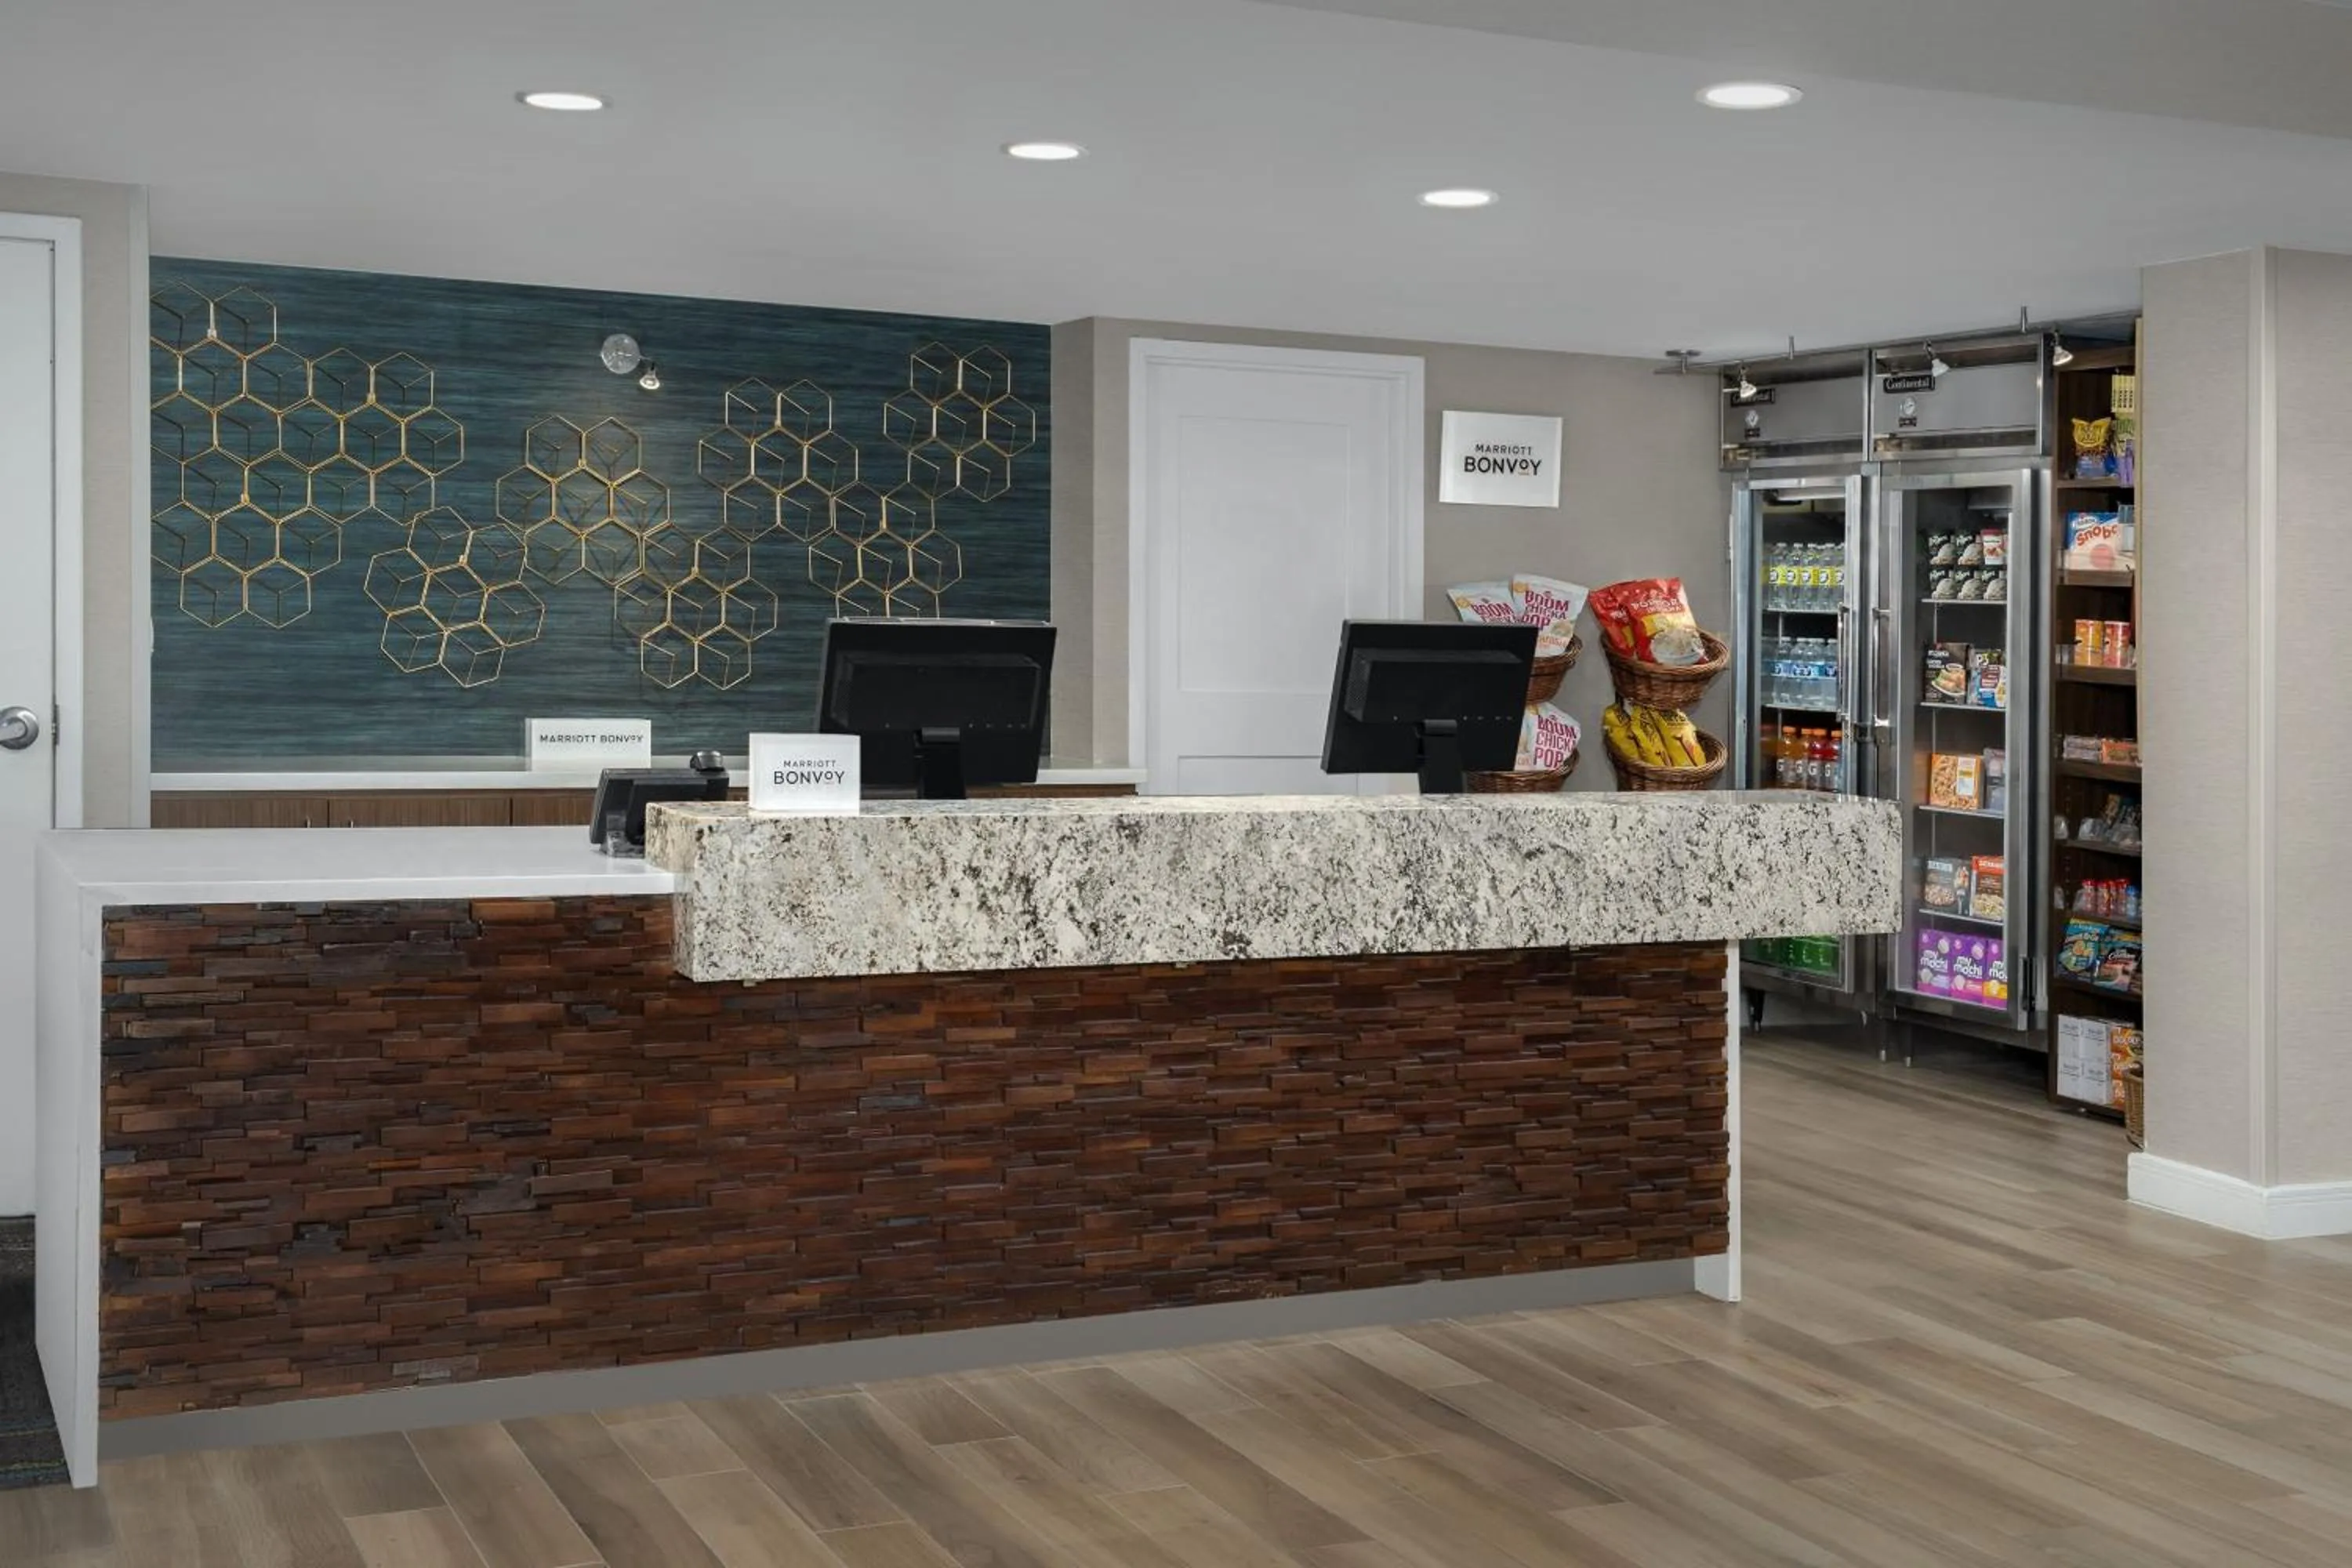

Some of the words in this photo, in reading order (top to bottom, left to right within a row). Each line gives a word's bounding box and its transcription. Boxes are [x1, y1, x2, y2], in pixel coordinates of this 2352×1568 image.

[1475, 444, 1534, 456] MARRIOTT
[1464, 456, 1541, 475] BONVOY
[1525, 590, 1569, 612] BOOM
[1537, 714, 1577, 739] BOOM
[539, 735, 596, 743] MARRIOTT
[600, 735, 643, 743] BONVOY
[1534, 747, 1563, 768] POP
[774, 771, 844, 784] BONVOY
